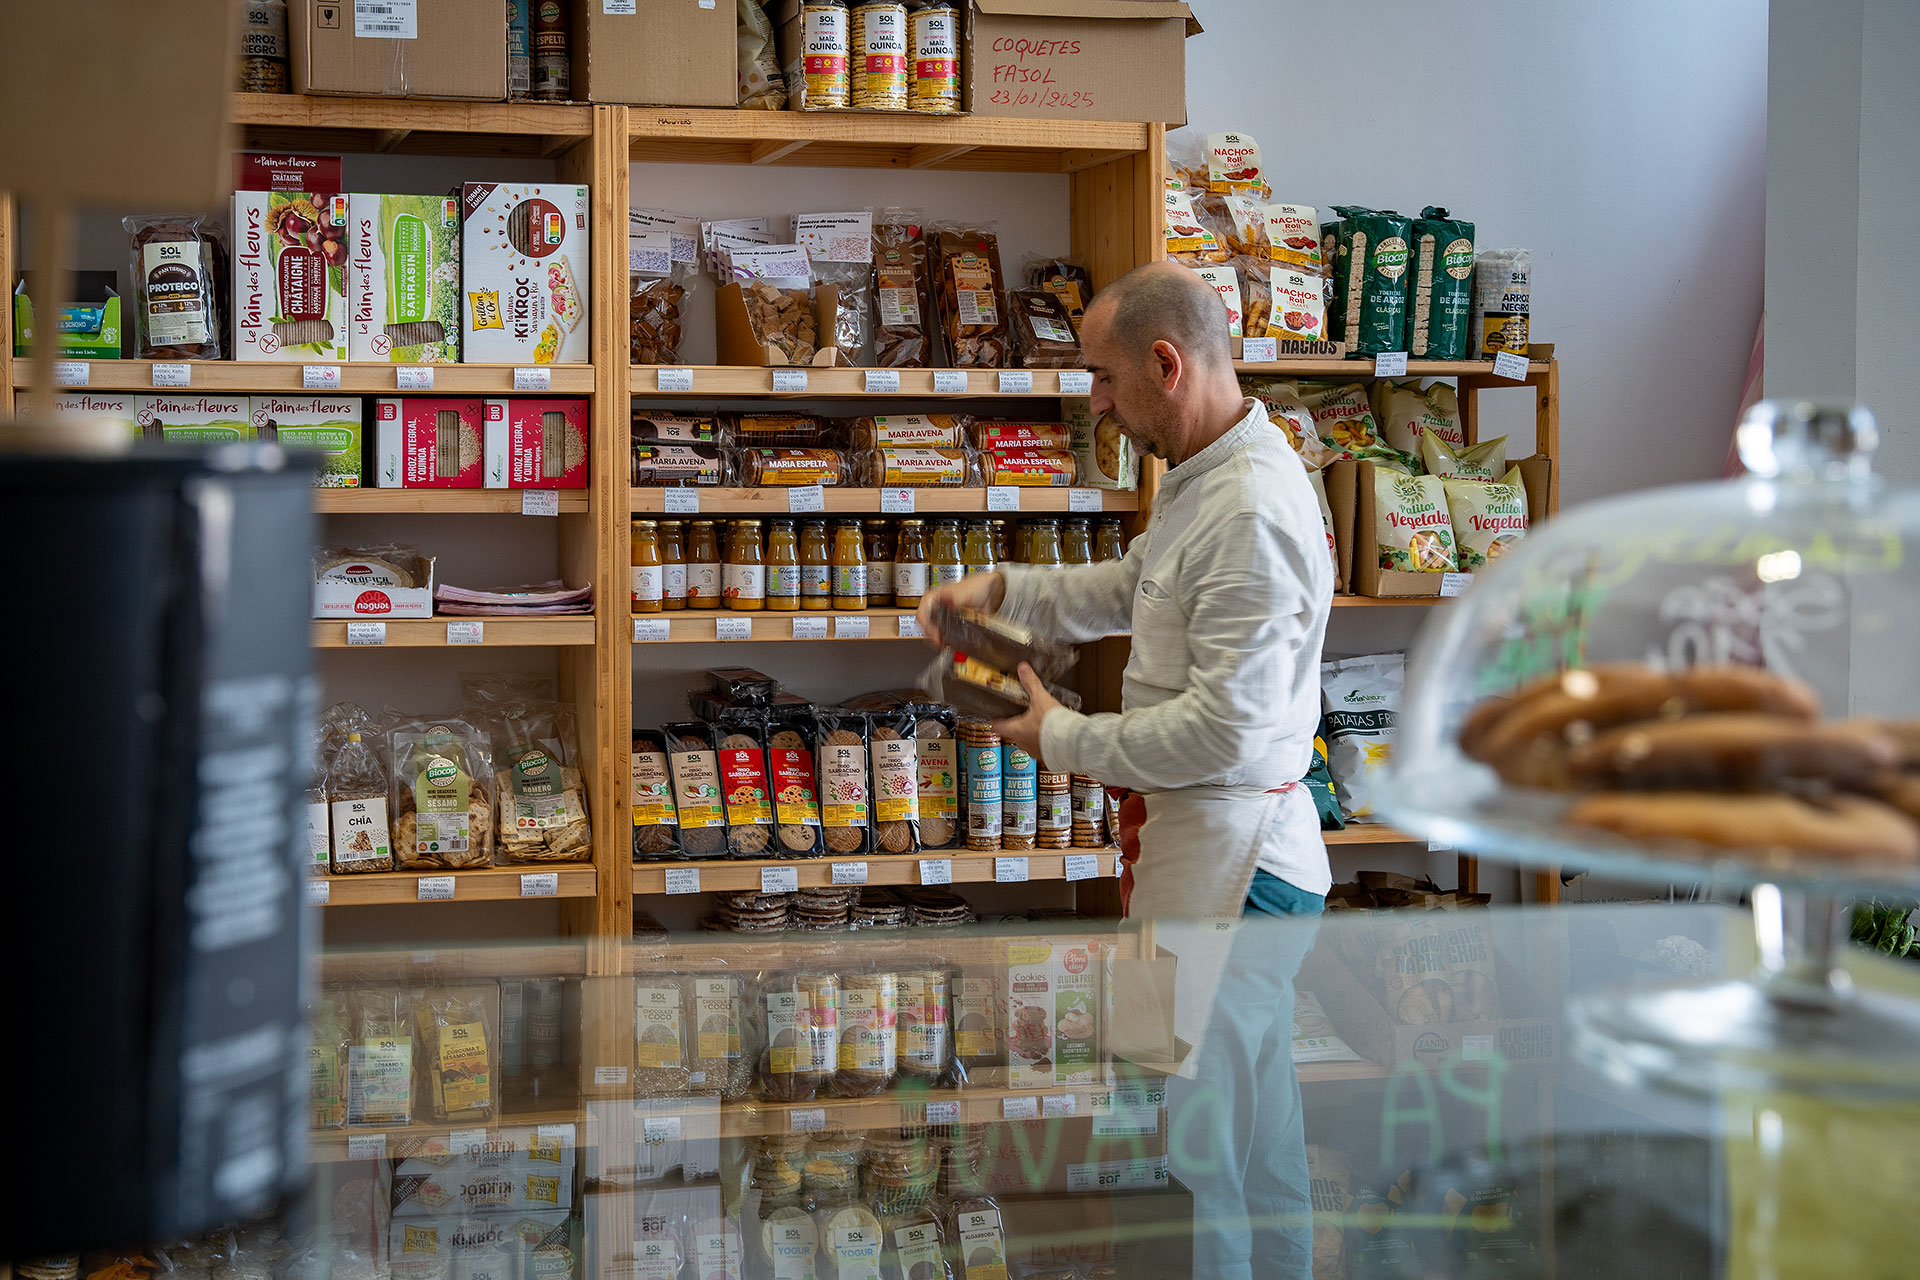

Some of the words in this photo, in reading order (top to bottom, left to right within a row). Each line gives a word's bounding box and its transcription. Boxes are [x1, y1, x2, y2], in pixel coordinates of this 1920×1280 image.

[249, 11, 269, 20] SOL
[241, 35, 276, 46] ARROZ
[536, 35, 566, 46] ESPELTA
[869, 41, 902, 50] QUINOA
[241, 45, 277, 56] NEGRO
[809, 42, 842, 51] QUINOA
[920, 46, 953, 55] QUINOA
[992, 36, 1081, 63] COQUETES
[989, 89, 1096, 109] 23/01/2025
[1214, 148, 1254, 156] NACHOS
[260, 156, 279, 167] Pain
[286, 156, 317, 167] fleurs
[465, 184, 484, 204] FORMAT
[470, 189, 490, 210] FAMILIAL
[1270, 217, 1313, 227] NACHOS
[1285, 222, 1301, 230] Roll
[239, 207, 261, 272] fleurs
[161, 246, 181, 255] SOL
[354, 219, 371, 275] fleurs
[1377, 251, 1408, 264] Biocop
[1445, 253, 1473, 267] Biocop
[158, 267, 169, 276] PAN
[169, 266, 187, 275] TIERNO
[246, 271, 258, 292] des
[1201, 272, 1216, 281] SOL
[1511, 272, 1527, 281] SOL
[149, 282, 198, 293] PROTEICO
[289, 256, 303, 314] CHÂTAIGNE
[360, 274, 370, 292] des
[407, 254, 416, 317] SARRASIN
[1276, 286, 1318, 301] NACHOS
[1502, 293, 1529, 303] ARROZ
[1289, 296, 1305, 304] Roll
[1382, 296, 1405, 304] ARROZ
[1439, 296, 1451, 304] DE
[1452, 297, 1470, 305] ARROZ
[240, 292, 262, 329] Pain
[355, 292, 373, 323] Pain
[478, 294, 488, 327] Grillon
[514, 277, 530, 339] Ki'KROC
[1501, 303, 1529, 312] NEGRO
[358, 323, 368, 335] Le
[245, 329, 257, 344] Le
[1280, 339, 1337, 355] NACHOS
[65, 402, 79, 410] des
[79, 397, 124, 412] fleurs
[146, 401, 155, 410] Le
[156, 398, 181, 413] Pain
[181, 403, 196, 412] des
[196, 398, 239, 414] fleurs
[261, 402, 270, 410] Le
[271, 399, 295, 414] Pain
[295, 404, 310, 413] des
[310, 399, 351, 415] fleurs
[384, 405, 394, 420] BIO
[490, 405, 500, 420] BIO
[888, 430, 915, 439] MARIA
[916, 429, 943, 438] AVENA
[995, 440, 1021, 448] MARIA
[1023, 439, 1053, 447] ESPELTA
[418, 447, 427, 474] QUINOA
[524, 447, 533, 474] QUINOA
[651, 458, 677, 466] MARIA
[678, 458, 706, 466] AVENA
[769, 460, 796, 468] MARIA
[796, 460, 828, 468] ESPELTA
[897, 458, 924, 467] MARIA
[925, 458, 952, 467] AVENA
[1003, 458, 1028, 466] MARIA
[1029, 457, 1063, 466] ESPELTA
[408, 458, 417, 482] ARROZ
[514, 458, 523, 482] ARROZ
[418, 475, 427, 483] Y
[524, 475, 533, 483] Y
[1399, 503, 1435, 515] Palitos
[1485, 503, 1521, 515] Palitos
[1385, 510, 1450, 530] Vegetales
[356, 602, 390, 611] nagual
[521, 756, 547, 769] Biocop
[920, 758, 949, 766] AVENA
[429, 767, 457, 777] Biocop
[779, 770, 810, 778] SARRACENO
[1039, 774, 1068, 784] ESPELTA
[522, 785, 552, 793] ROMERO
[976, 781, 999, 790] AVENA
[1007, 780, 1032, 789] AVENA
[973, 790, 1001, 798] INTEGRAL
[1004, 789, 1034, 797] INTEGRAL
[427, 799, 458, 808] SÉSAMO
[348, 816, 373, 826] CHÍA
[1015, 973, 1046, 982] Cookies
[1057, 975, 1079, 984] GLUTEN
[1080, 974, 1094, 983] FREE
[971, 1215, 986, 1224] SOL
[848, 1231, 863, 1241] SOL
[965, 1231, 995, 1240] ALGARROBA
[646, 1245, 661, 1253] SOL
[778, 1247, 810, 1256] YOGUR
[841, 1248, 873, 1258] YOGUR
[903, 1246, 935, 1256] ALGARROBA
[535, 1259, 573, 1271] Biocop
